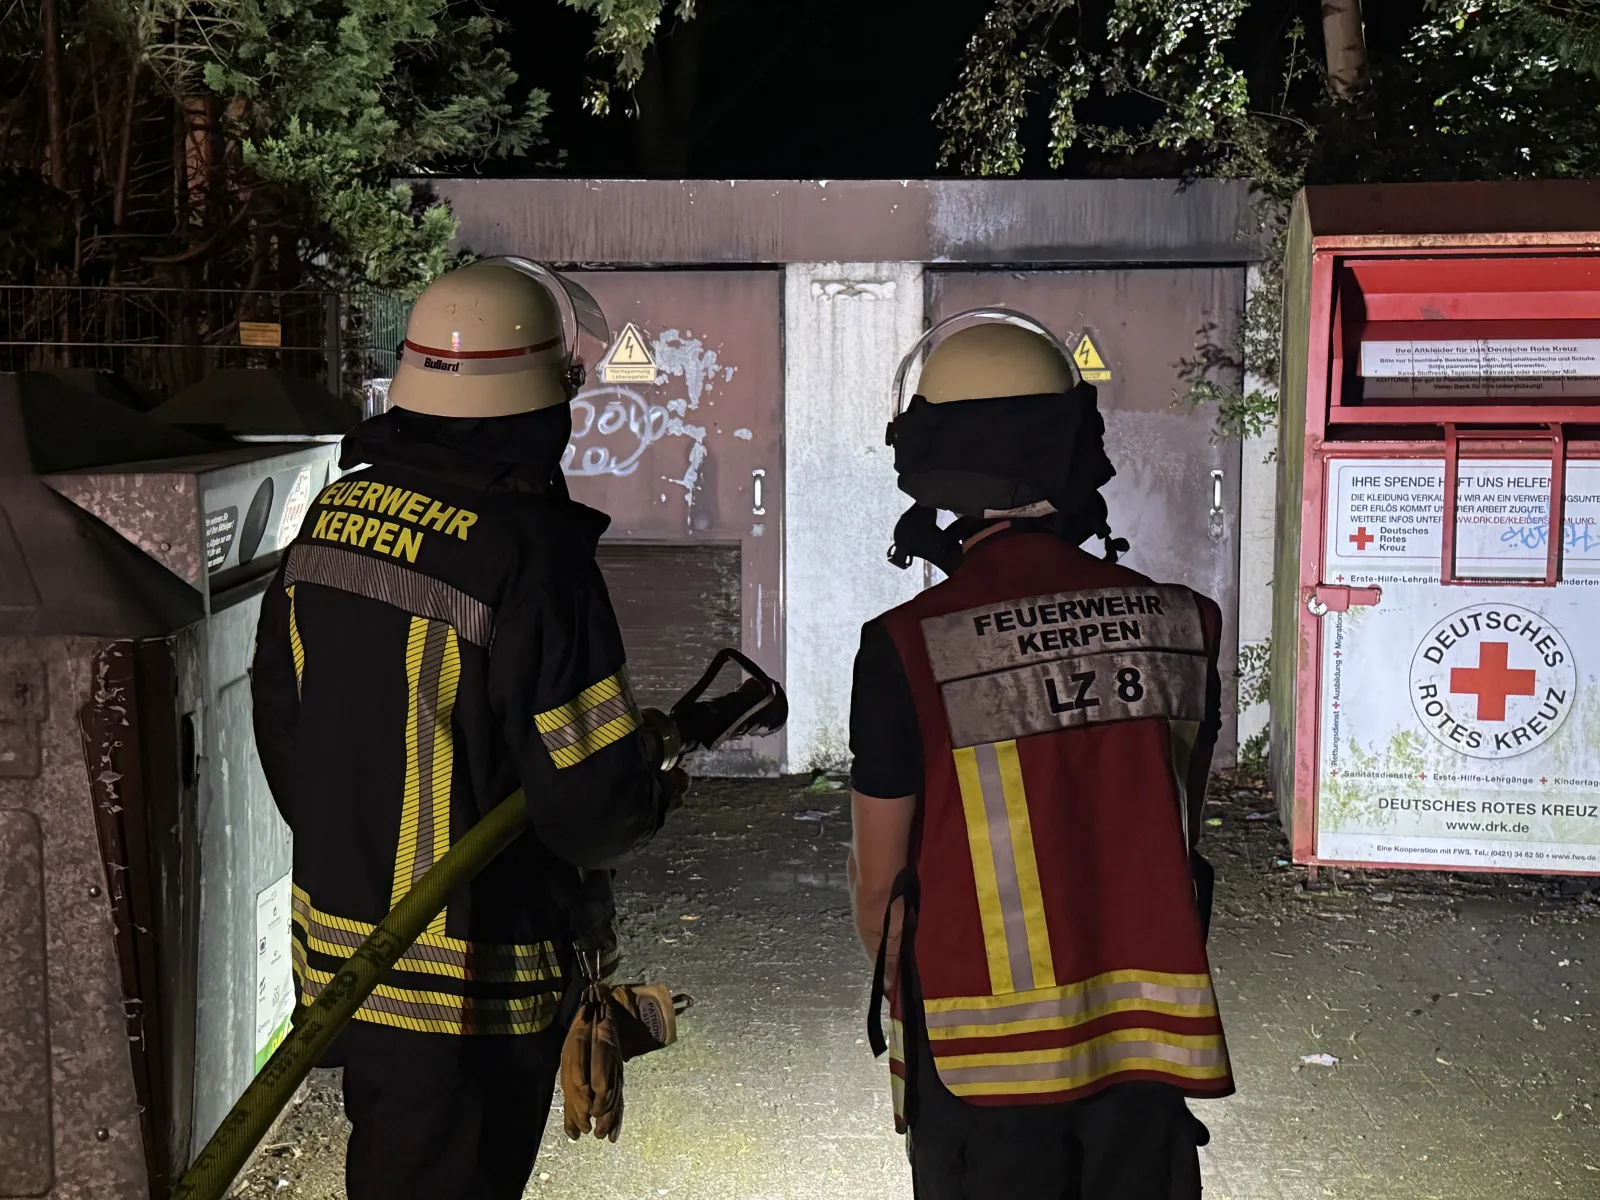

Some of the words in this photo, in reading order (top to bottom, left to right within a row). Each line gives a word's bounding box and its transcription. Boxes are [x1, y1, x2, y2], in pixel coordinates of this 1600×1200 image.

[423, 357, 460, 372] Bullard
[1352, 476, 1381, 487] IHRE
[1384, 476, 1435, 487] SPENDE
[1438, 476, 1474, 488] HFT
[1476, 477, 1504, 488] UNS
[1351, 493, 1365, 501] DIE
[1366, 493, 1409, 502] KLEIDUNG
[1464, 494, 1481, 502] WIR
[1483, 494, 1495, 502] AN
[1497, 494, 1511, 502] EIN
[318, 480, 478, 541] EUERWEHR
[1350, 504, 1368, 512] DER
[1370, 503, 1398, 512] ERLÖS
[1399, 504, 1432, 513] KOMMT
[1476, 505, 1507, 513] ARBEIT
[1509, 505, 1546, 514] ZUGUTE.
[1350, 515, 1387, 523] WEITERE
[1388, 516, 1414, 524] INFOS
[311, 510, 424, 564] KERPEN
[1379, 526, 1429, 535] Deutsches
[1379, 535, 1407, 543] Rotes
[1379, 543, 1407, 552] Kreuz
[973, 595, 1165, 636] FEUERWEHR
[1017, 619, 1142, 655] KERPEN
[1423, 610, 1564, 668] DEUTSCHES
[1334, 659, 1343, 700] Ausbildung
[1045, 670, 1100, 714] LZ
[1116, 667, 1144, 702] 8
[1418, 683, 1482, 749] ROTES
[1494, 687, 1567, 750] KREUZ
[1332, 710, 1341, 766] Rettungsdienst
[1433, 773, 1533, 784] Erste-Hilfe-Lehrgänge
[1554, 778, 1600, 787] Kindertag
[1378, 797, 1477, 813] DEUTSCHES
[1481, 801, 1537, 815] ROTES
[1541, 803, 1599, 818] KREUZ
[1446, 821, 1530, 833] www.drk.de
[1394, 845, 1438, 854] Kooperation
[1490, 850, 1512, 858] (0421)
[1551, 853, 1597, 861] www.fws.de
